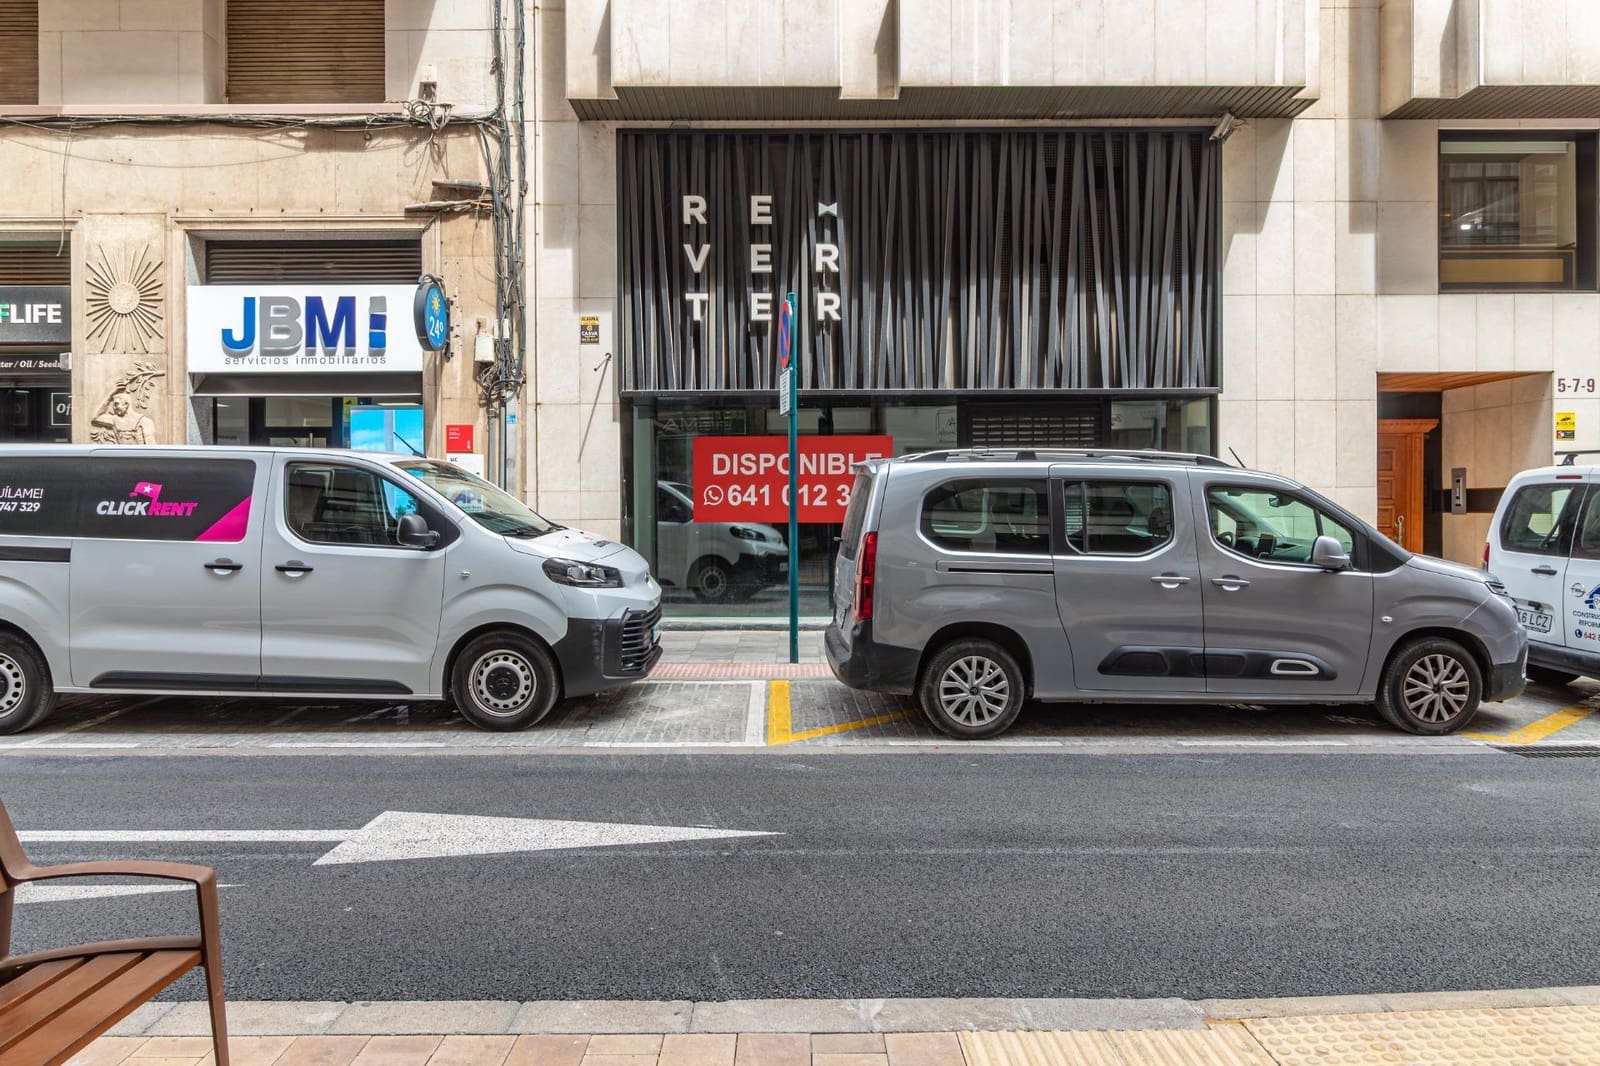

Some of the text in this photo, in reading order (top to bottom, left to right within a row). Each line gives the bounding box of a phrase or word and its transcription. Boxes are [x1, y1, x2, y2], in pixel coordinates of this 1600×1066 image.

[19, 360, 32, 368] Oil
[224, 354, 387, 365] servicios inmobiliarios
[1557, 378, 1596, 393] 5-7-9
[727, 484, 770, 506] 641
[19, 502, 41, 512] 329
[1529, 613, 1549, 628] LCZ
